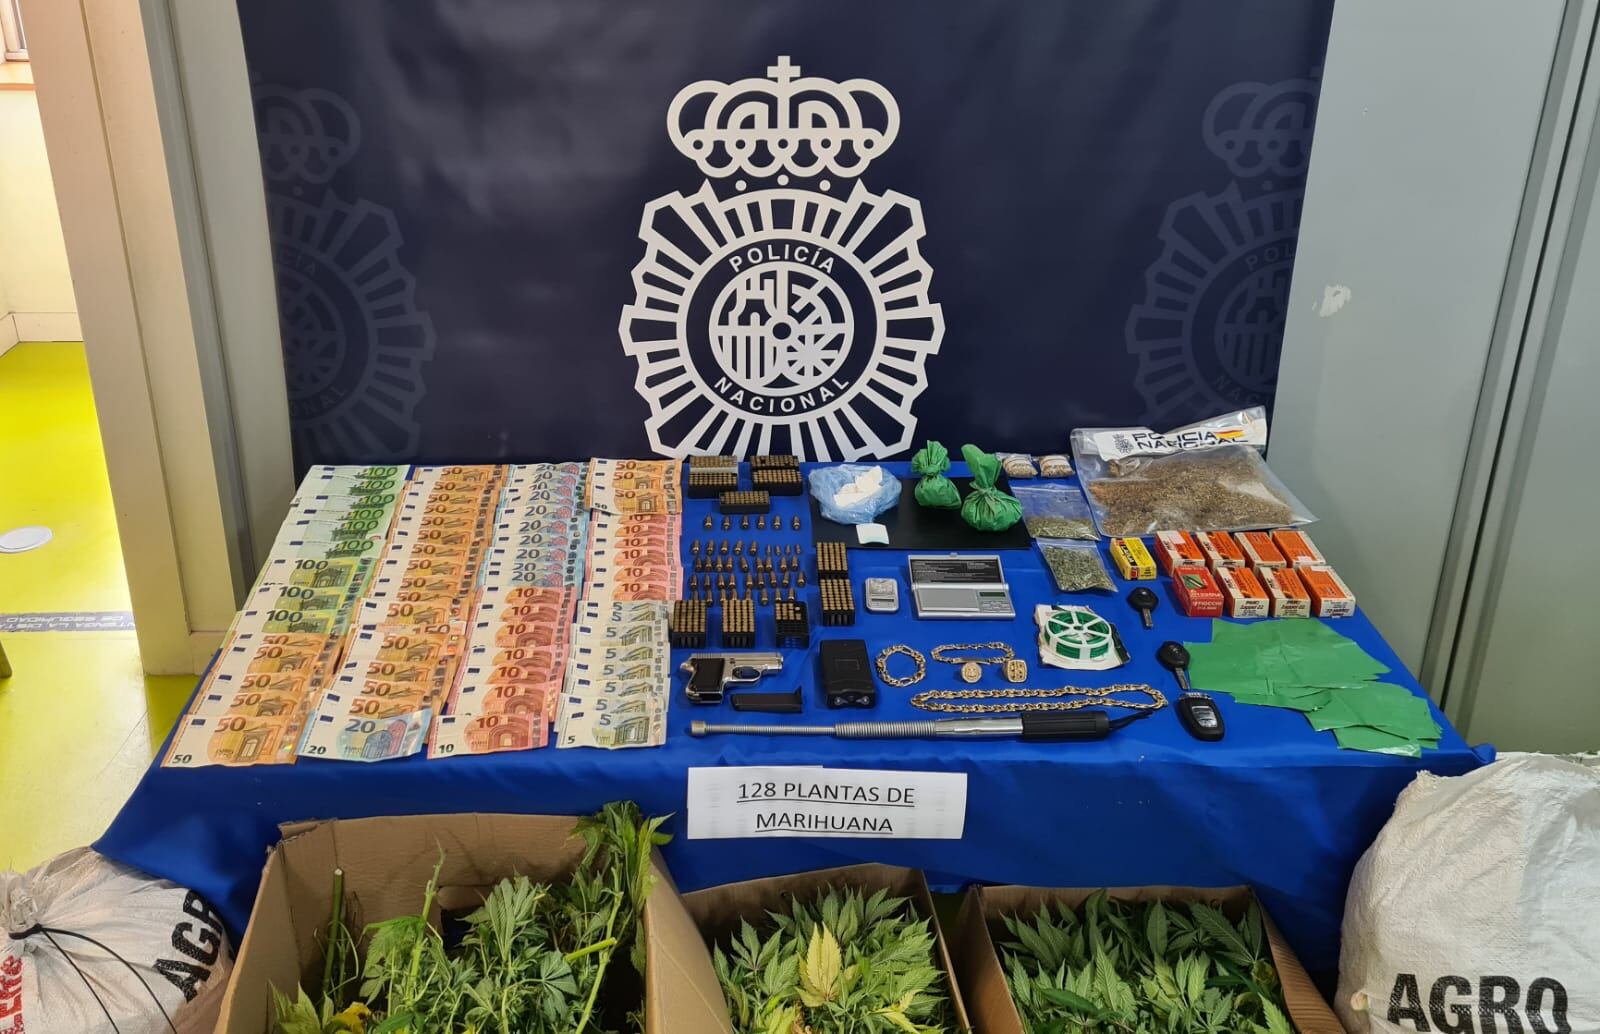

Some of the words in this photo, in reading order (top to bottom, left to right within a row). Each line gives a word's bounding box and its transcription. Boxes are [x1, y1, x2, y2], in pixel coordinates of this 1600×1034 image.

[728, 243, 834, 273] POLICÍA
[714, 376, 850, 413] NACIONAL
[441, 466, 462, 476] 50
[616, 461, 636, 470] 50
[368, 467, 398, 477] 100
[614, 472, 634, 480] 50
[365, 480, 395, 490] 100
[433, 481, 456, 490] 50
[364, 494, 395, 504] 100
[427, 494, 450, 503] 50
[530, 490, 550, 501] 20
[615, 490, 636, 498] 50
[352, 509, 384, 520] 100
[424, 504, 446, 514] 50
[525, 504, 546, 516] 20
[345, 520, 378, 531] 100
[421, 516, 444, 526] 50
[520, 520, 542, 532] 20
[418, 530, 442, 540] 50
[624, 525, 640, 534] 10
[520, 534, 542, 545] 20
[624, 538, 640, 546] 10
[341, 540, 374, 551] 100
[412, 544, 436, 554] 50
[516, 549, 540, 560] 20
[622, 549, 640, 560] 10
[295, 559, 328, 571] 100
[407, 560, 431, 570] 50
[512, 572, 536, 582] 20
[624, 568, 643, 577] 10
[401, 578, 426, 588] 50
[622, 583, 640, 592] 10
[279, 586, 314, 600] 100
[515, 588, 534, 598] 10
[387, 604, 414, 617] 50
[512, 606, 531, 616] 10
[612, 602, 622, 610] 5
[267, 610, 303, 622] 100
[612, 612, 622, 622] 5
[506, 624, 526, 634] 10
[606, 627, 616, 638] 5
[380, 636, 410, 650] 50
[254, 646, 282, 659] 50
[504, 649, 524, 660] 10
[606, 648, 616, 658] 5
[366, 662, 395, 676] 50
[499, 666, 520, 678] 10
[602, 664, 614, 675] 5
[241, 674, 271, 688] 50
[361, 681, 391, 696] 50
[495, 686, 516, 698] 10
[604, 682, 616, 692] 5
[231, 694, 260, 707] 50
[596, 699, 608, 710] 5
[349, 700, 380, 715] 50
[214, 717, 246, 732] 50
[476, 716, 498, 728] 10
[600, 714, 611, 726] 5
[345, 718, 376, 734] 20
[567, 735, 576, 744] 5
[308, 745, 326, 754] 20
[438, 744, 454, 754] 10
[172, 754, 192, 764] 50
[738, 782, 776, 800] 128
[785, 782, 879, 802] PLANTAS
[887, 787, 915, 804] DE
[756, 813, 893, 832] MARIHUANA
[1387, 973, 1572, 1034] AGRO
